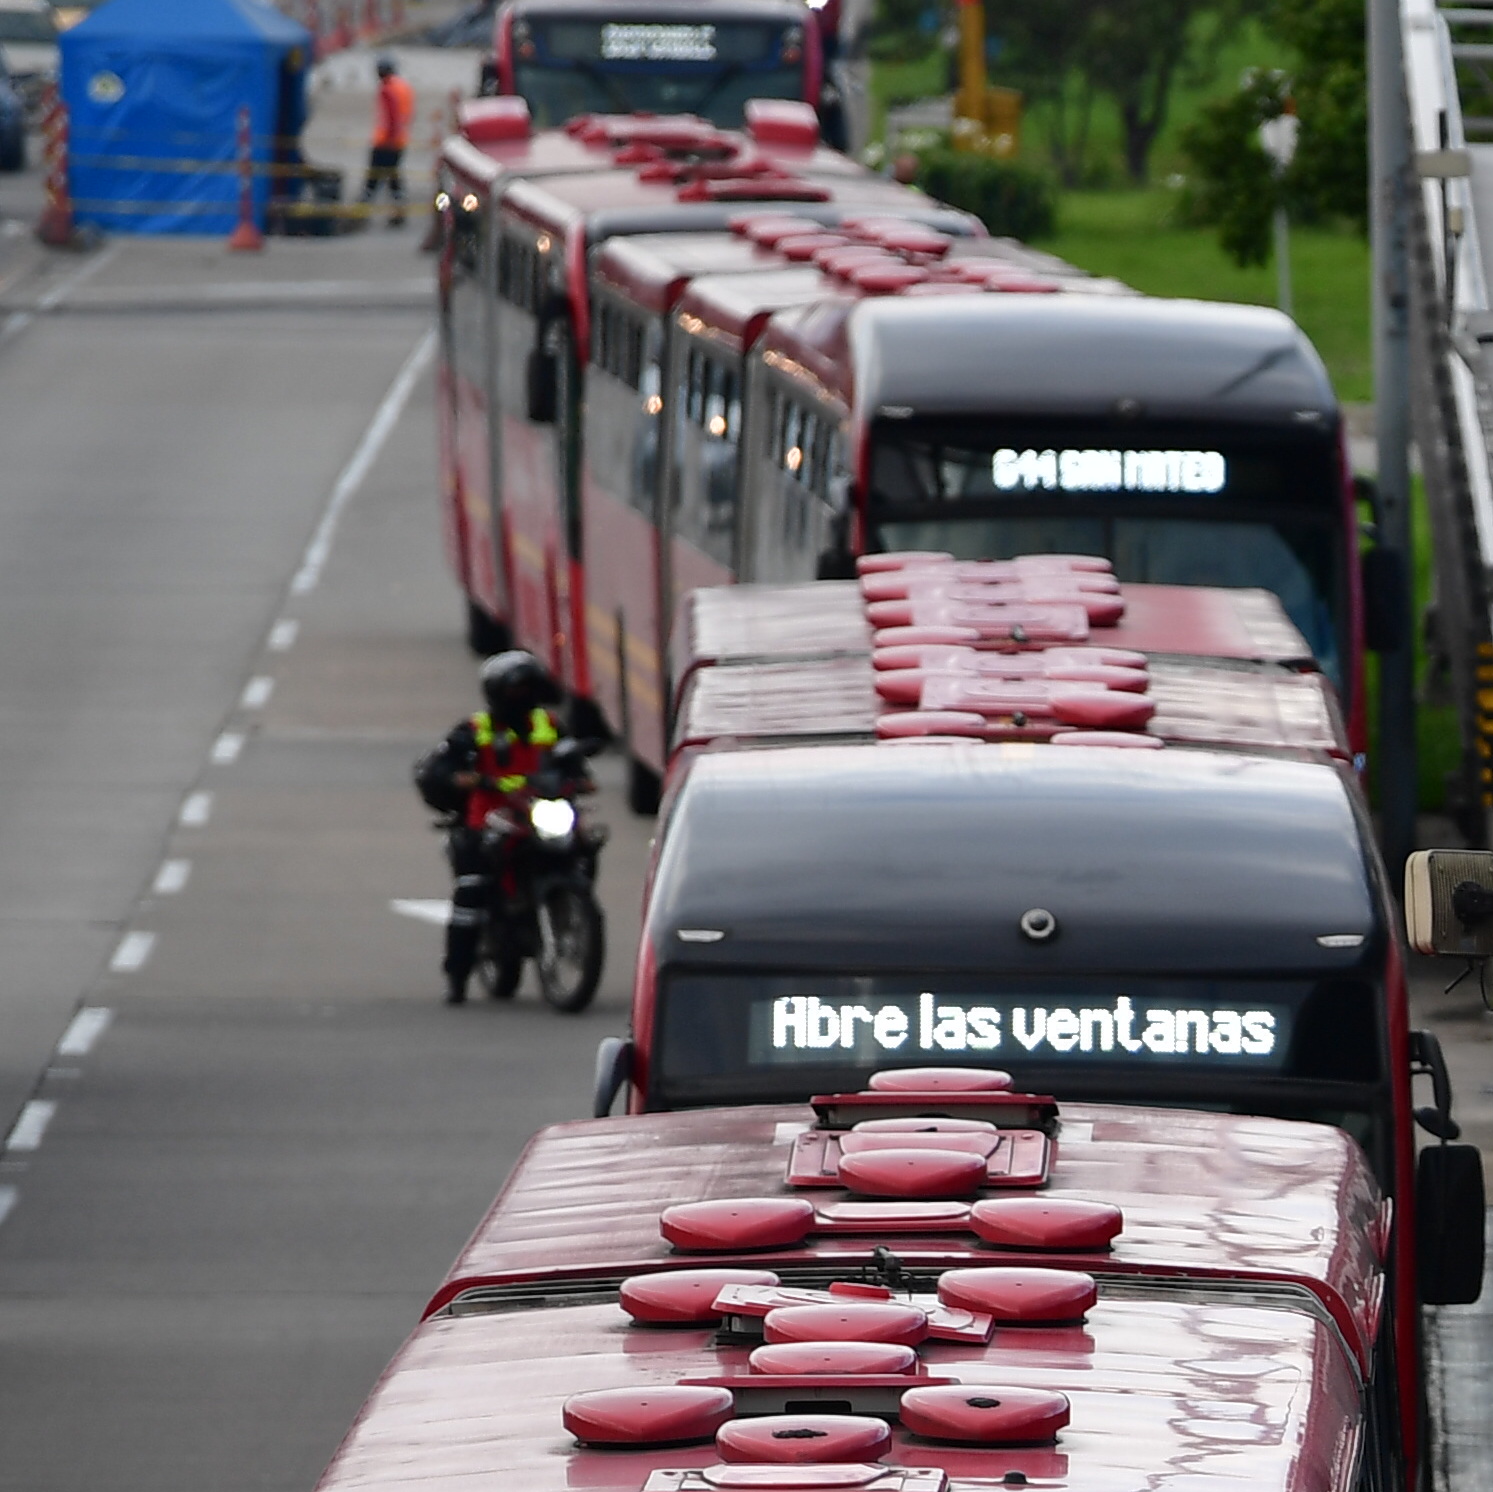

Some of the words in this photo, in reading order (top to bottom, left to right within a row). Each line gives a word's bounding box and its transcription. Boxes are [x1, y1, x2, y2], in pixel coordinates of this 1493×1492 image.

[773, 996, 908, 1050] Abre
[920, 993, 1002, 1051] las
[1012, 996, 1276, 1054] ventanas
